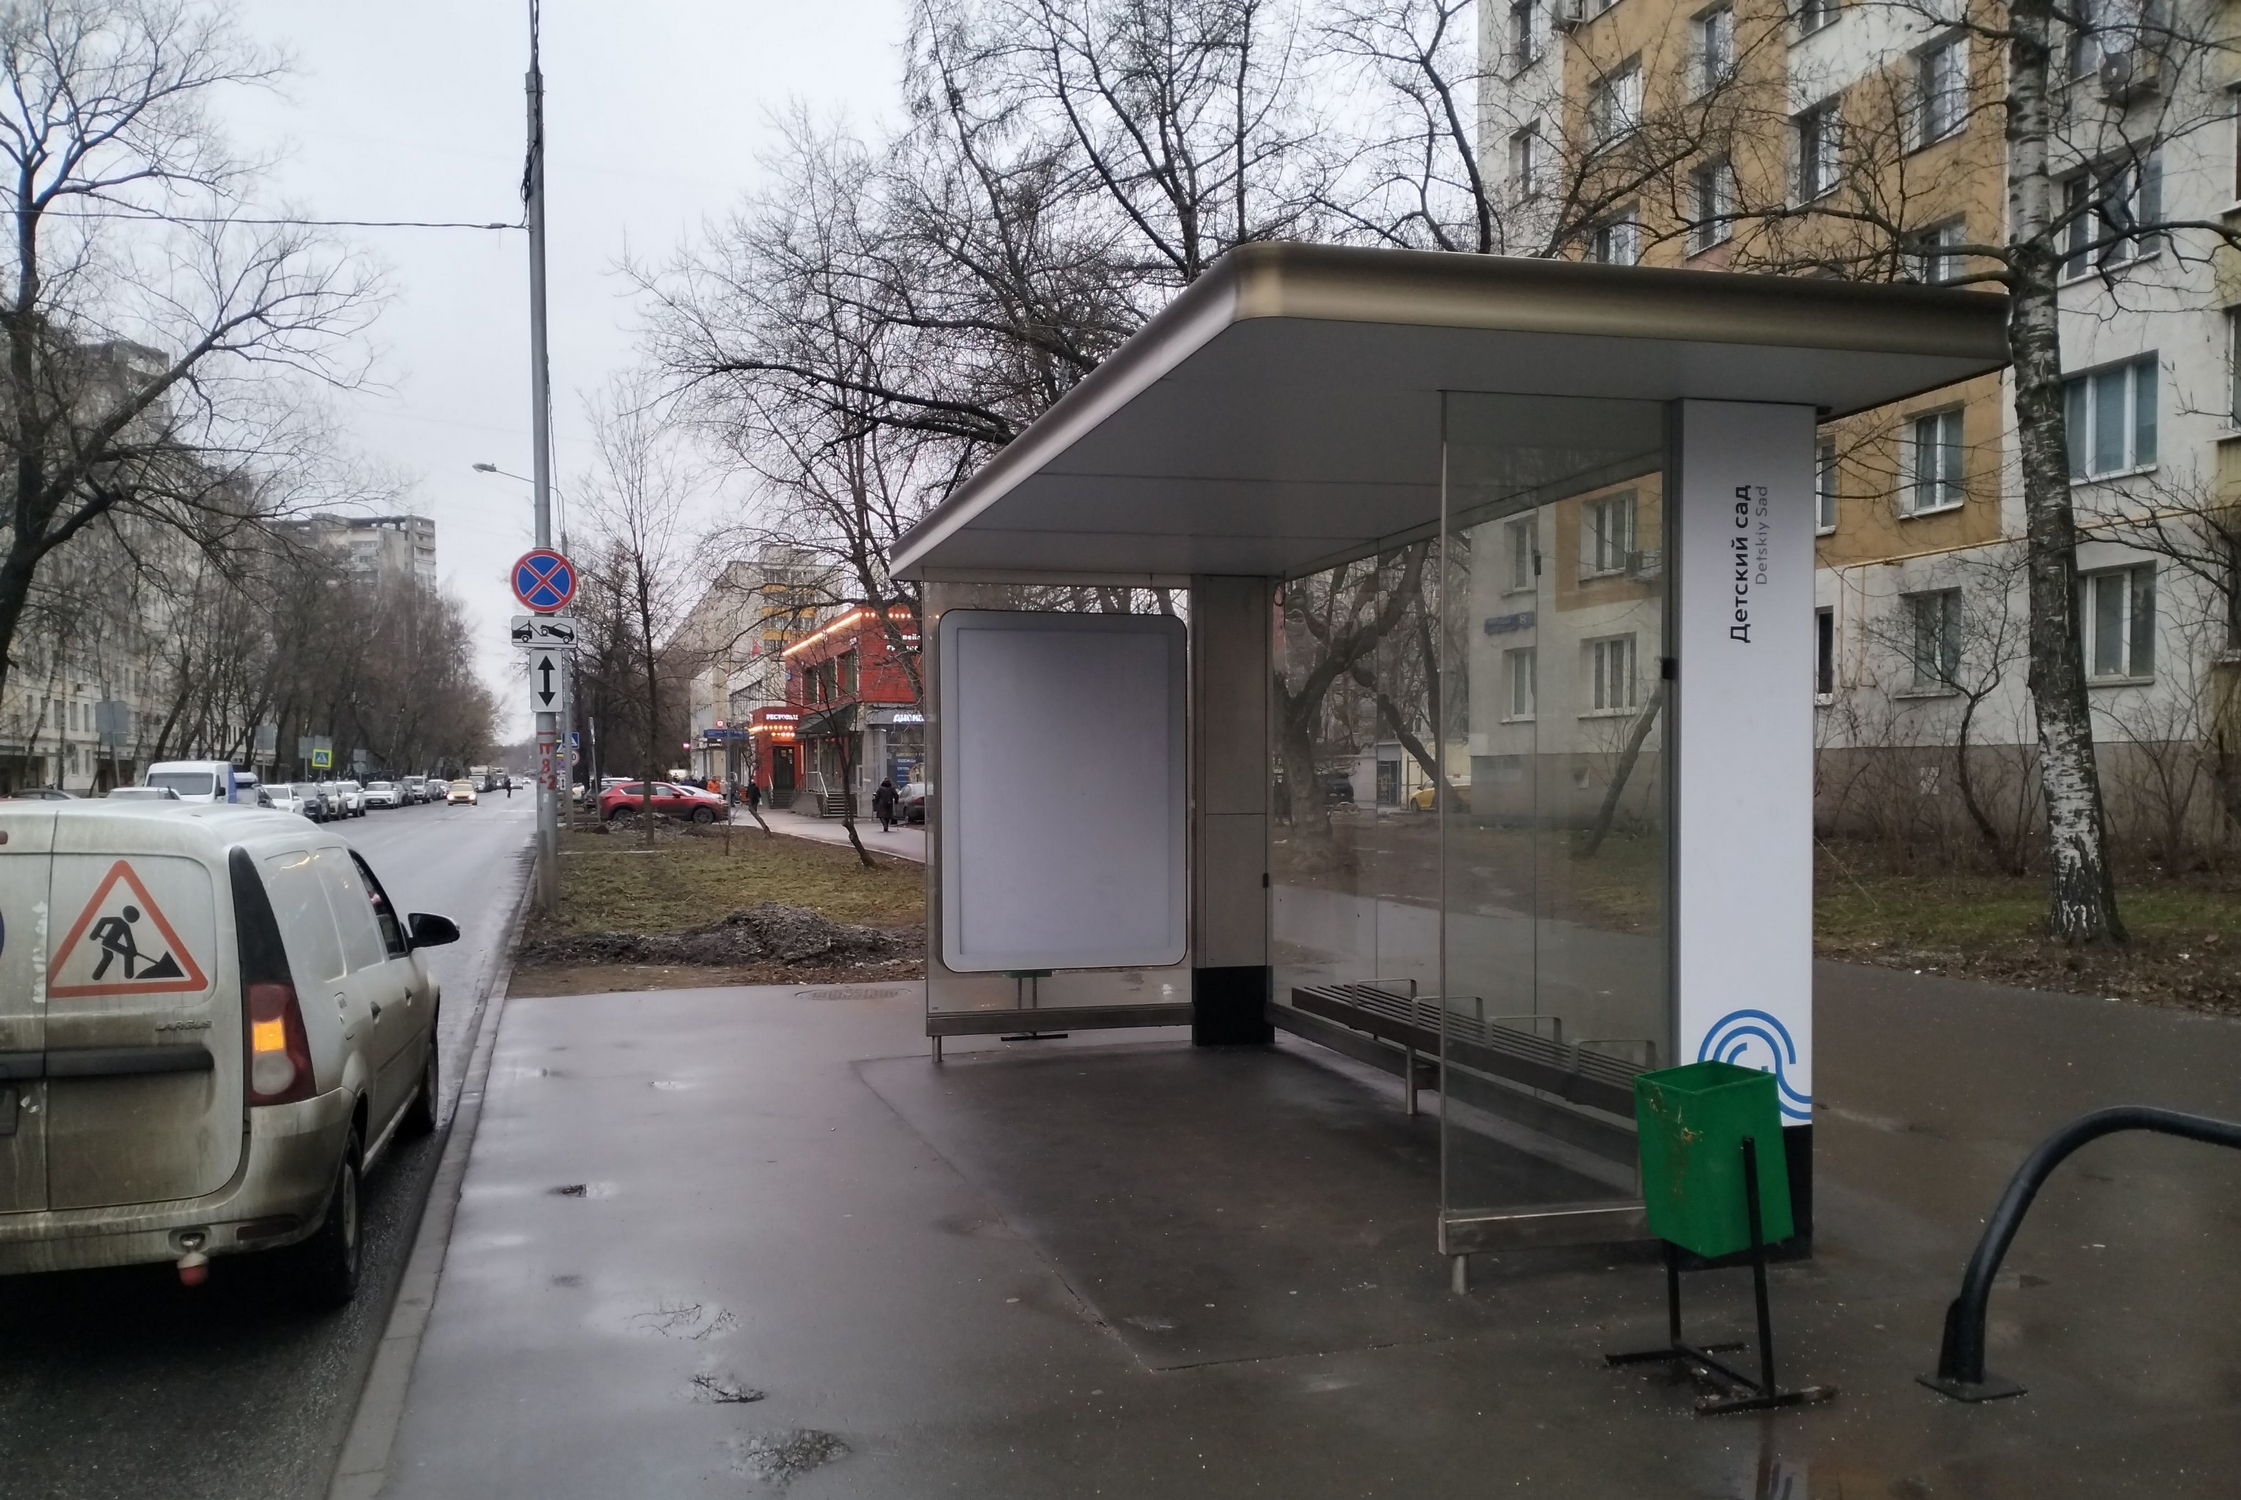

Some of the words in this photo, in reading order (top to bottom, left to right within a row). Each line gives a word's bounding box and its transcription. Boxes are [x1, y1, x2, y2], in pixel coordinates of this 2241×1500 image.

[1735, 485, 1751, 529] сад
[1755, 486, 1768, 517] Sad
[1755, 521, 1770, 585] Detskiy
[1730, 537, 1751, 644] Детский
